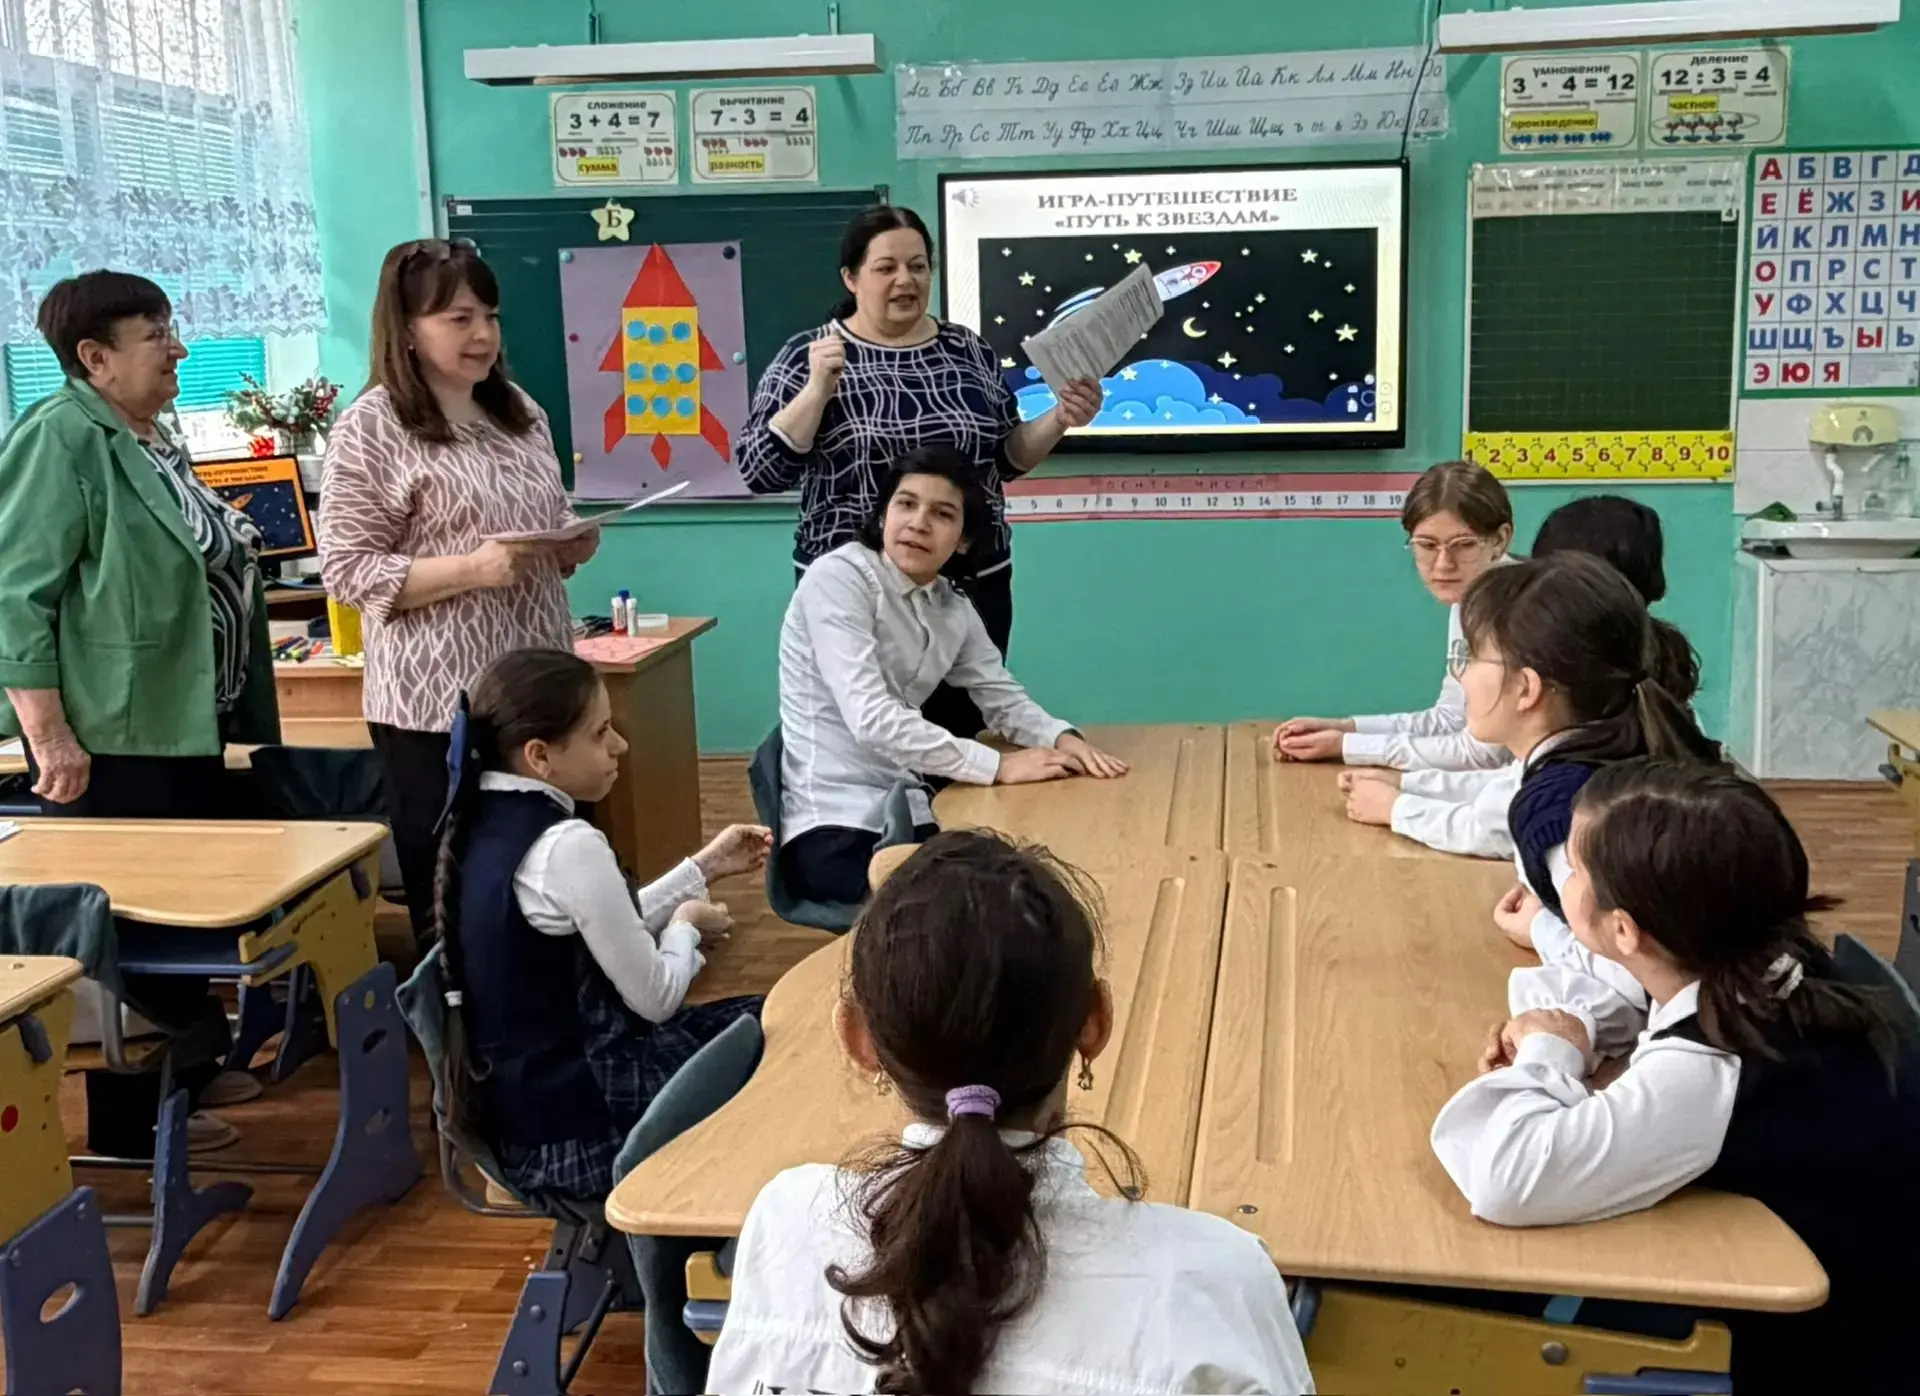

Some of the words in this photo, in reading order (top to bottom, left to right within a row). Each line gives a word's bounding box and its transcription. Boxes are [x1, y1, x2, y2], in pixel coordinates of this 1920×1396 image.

[1690, 56, 1748, 66] деление
[904, 81, 931, 97] Аа
[939, 78, 968, 97] Бб
[972, 77, 995, 96] Вв
[1004, 76, 1023, 95] Гг
[1032, 76, 1059, 102] Дд
[1068, 75, 1089, 93] Ее
[1128, 73, 1163, 91] Жж
[1175, 71, 1193, 96] Зз
[1201, 70, 1229, 88] Ии
[1271, 64, 1300, 85] Кк
[1306, 64, 1335, 83] Лл
[1342, 62, 1378, 81] Мм
[1385, 60, 1414, 80] Нн
[1533, 65, 1610, 78] умножение
[1661, 69, 1689, 85] 12
[1712, 68, 1726, 84] 3
[1734, 71, 1746, 80] =
[1756, 66, 1769, 82] 4
[1513, 78, 1526, 93] 3
[1562, 76, 1576, 91] 4
[1585, 78, 1598, 88] =
[1607, 74, 1634, 90] 12
[587, 101, 647, 110] сложение
[720, 96, 785, 106] вычитание
[570, 114, 582, 129] 3
[589, 115, 601, 127] +
[608, 112, 621, 127] 4
[628, 115, 640, 125] =
[647, 112, 660, 127] 7
[711, 110, 723, 126] 7
[744, 109, 756, 125] 3
[770, 112, 782, 121] =
[796, 108, 809, 123] 4
[1511, 119, 1595, 129] произведение
[905, 125, 933, 144] Пп
[940, 124, 964, 150] Рр
[970, 123, 990, 142] Сс
[997, 122, 1035, 141] Тт
[1043, 121, 1063, 148] Уу
[1069, 120, 1096, 145] Фф
[1102, 120, 1130, 138] Хх
[1136, 120, 1163, 139] Цц
[1175, 120, 1197, 138] Чч
[1206, 119, 1241, 137] Шш
[1249, 117, 1284, 137] Щщ
[1351, 112, 1368, 130] Ээ
[1415, 108, 1439, 127] Яя
[711, 160, 763, 171] разность
[1760, 158, 1782, 181] А
[1798, 157, 1815, 179] Б
[1833, 157, 1852, 179] В
[1871, 155, 1887, 178] Г
[1903, 154, 1920, 177] Д
[1038, 188, 1297, 209] ИГРА-ПУТЕШЕСТВИЕ
[1761, 193, 1777, 215] Е
[1798, 188, 1813, 214] Ё
[1826, 191, 1855, 213] Ж
[1869, 190, 1885, 212] З
[1902, 189, 1920, 211] И
[606, 209, 622, 228] Б
[1055, 214, 1129, 228] «ПУТЬ
[1137, 213, 1152, 227] К
[1157, 210, 1280, 226] ЗВЕЗДАМ»
[1757, 224, 1778, 250] Й
[1792, 226, 1813, 248] К
[1826, 225, 1849, 247] Л
[1861, 224, 1888, 247] М
[1900, 224, 1920, 246] Н
[1755, 261, 1776, 282] О
[1790, 260, 1811, 282] П
[1828, 259, 1846, 281] Р
[1863, 258, 1880, 280] С
[1901, 258, 1916, 279] Т
[1754, 294, 1774, 316] У
[1786, 294, 1812, 315] Ф
[1824, 292, 1846, 315] Х
[1861, 292, 1883, 315] Ц
[1897, 290, 1916, 313] Ч
[1749, 328, 1777, 350] Ш
[1783, 328, 1813, 352] Щ
[1823, 327, 1844, 349] Ъ
[1857, 326, 1883, 348] Ы
[1896, 326, 1914, 347] Ь
[1753, 363, 1770, 383] Э
[1781, 363, 1810, 382] Ю
[1823, 362, 1840, 382] Я
[1464, 449, 1473, 464] 1
[1489, 449, 1500, 463] 2
[1517, 448, 1528, 463] 3
[1544, 448, 1556, 462] 4
[1572, 448, 1584, 462] 5
[1599, 447, 1610, 462] 6
[1625, 447, 1637, 461] 7
[1652, 447, 1663, 461] 8
[1679, 447, 1691, 461] 9
[1705, 446, 1729, 461] 10
[1031, 501, 1037, 510] 5
[1056, 499, 1063, 508] 6
[1082, 498, 1088, 508] 7
[1106, 497, 1112, 507] 8
[1132, 497, 1138, 507] 9
[1155, 497, 1167, 507] 10
[1181, 496, 1191, 507] 11
[1207, 496, 1218, 507] 12
[1233, 496, 1244, 506] 13
[1259, 496, 1270, 506] 14
[1284, 496, 1296, 506] 15
[1311, 495, 1322, 505] 16
[1337, 495, 1348, 505] 17
[1363, 495, 1375, 505] 18
[1390, 495, 1401, 505] 19
